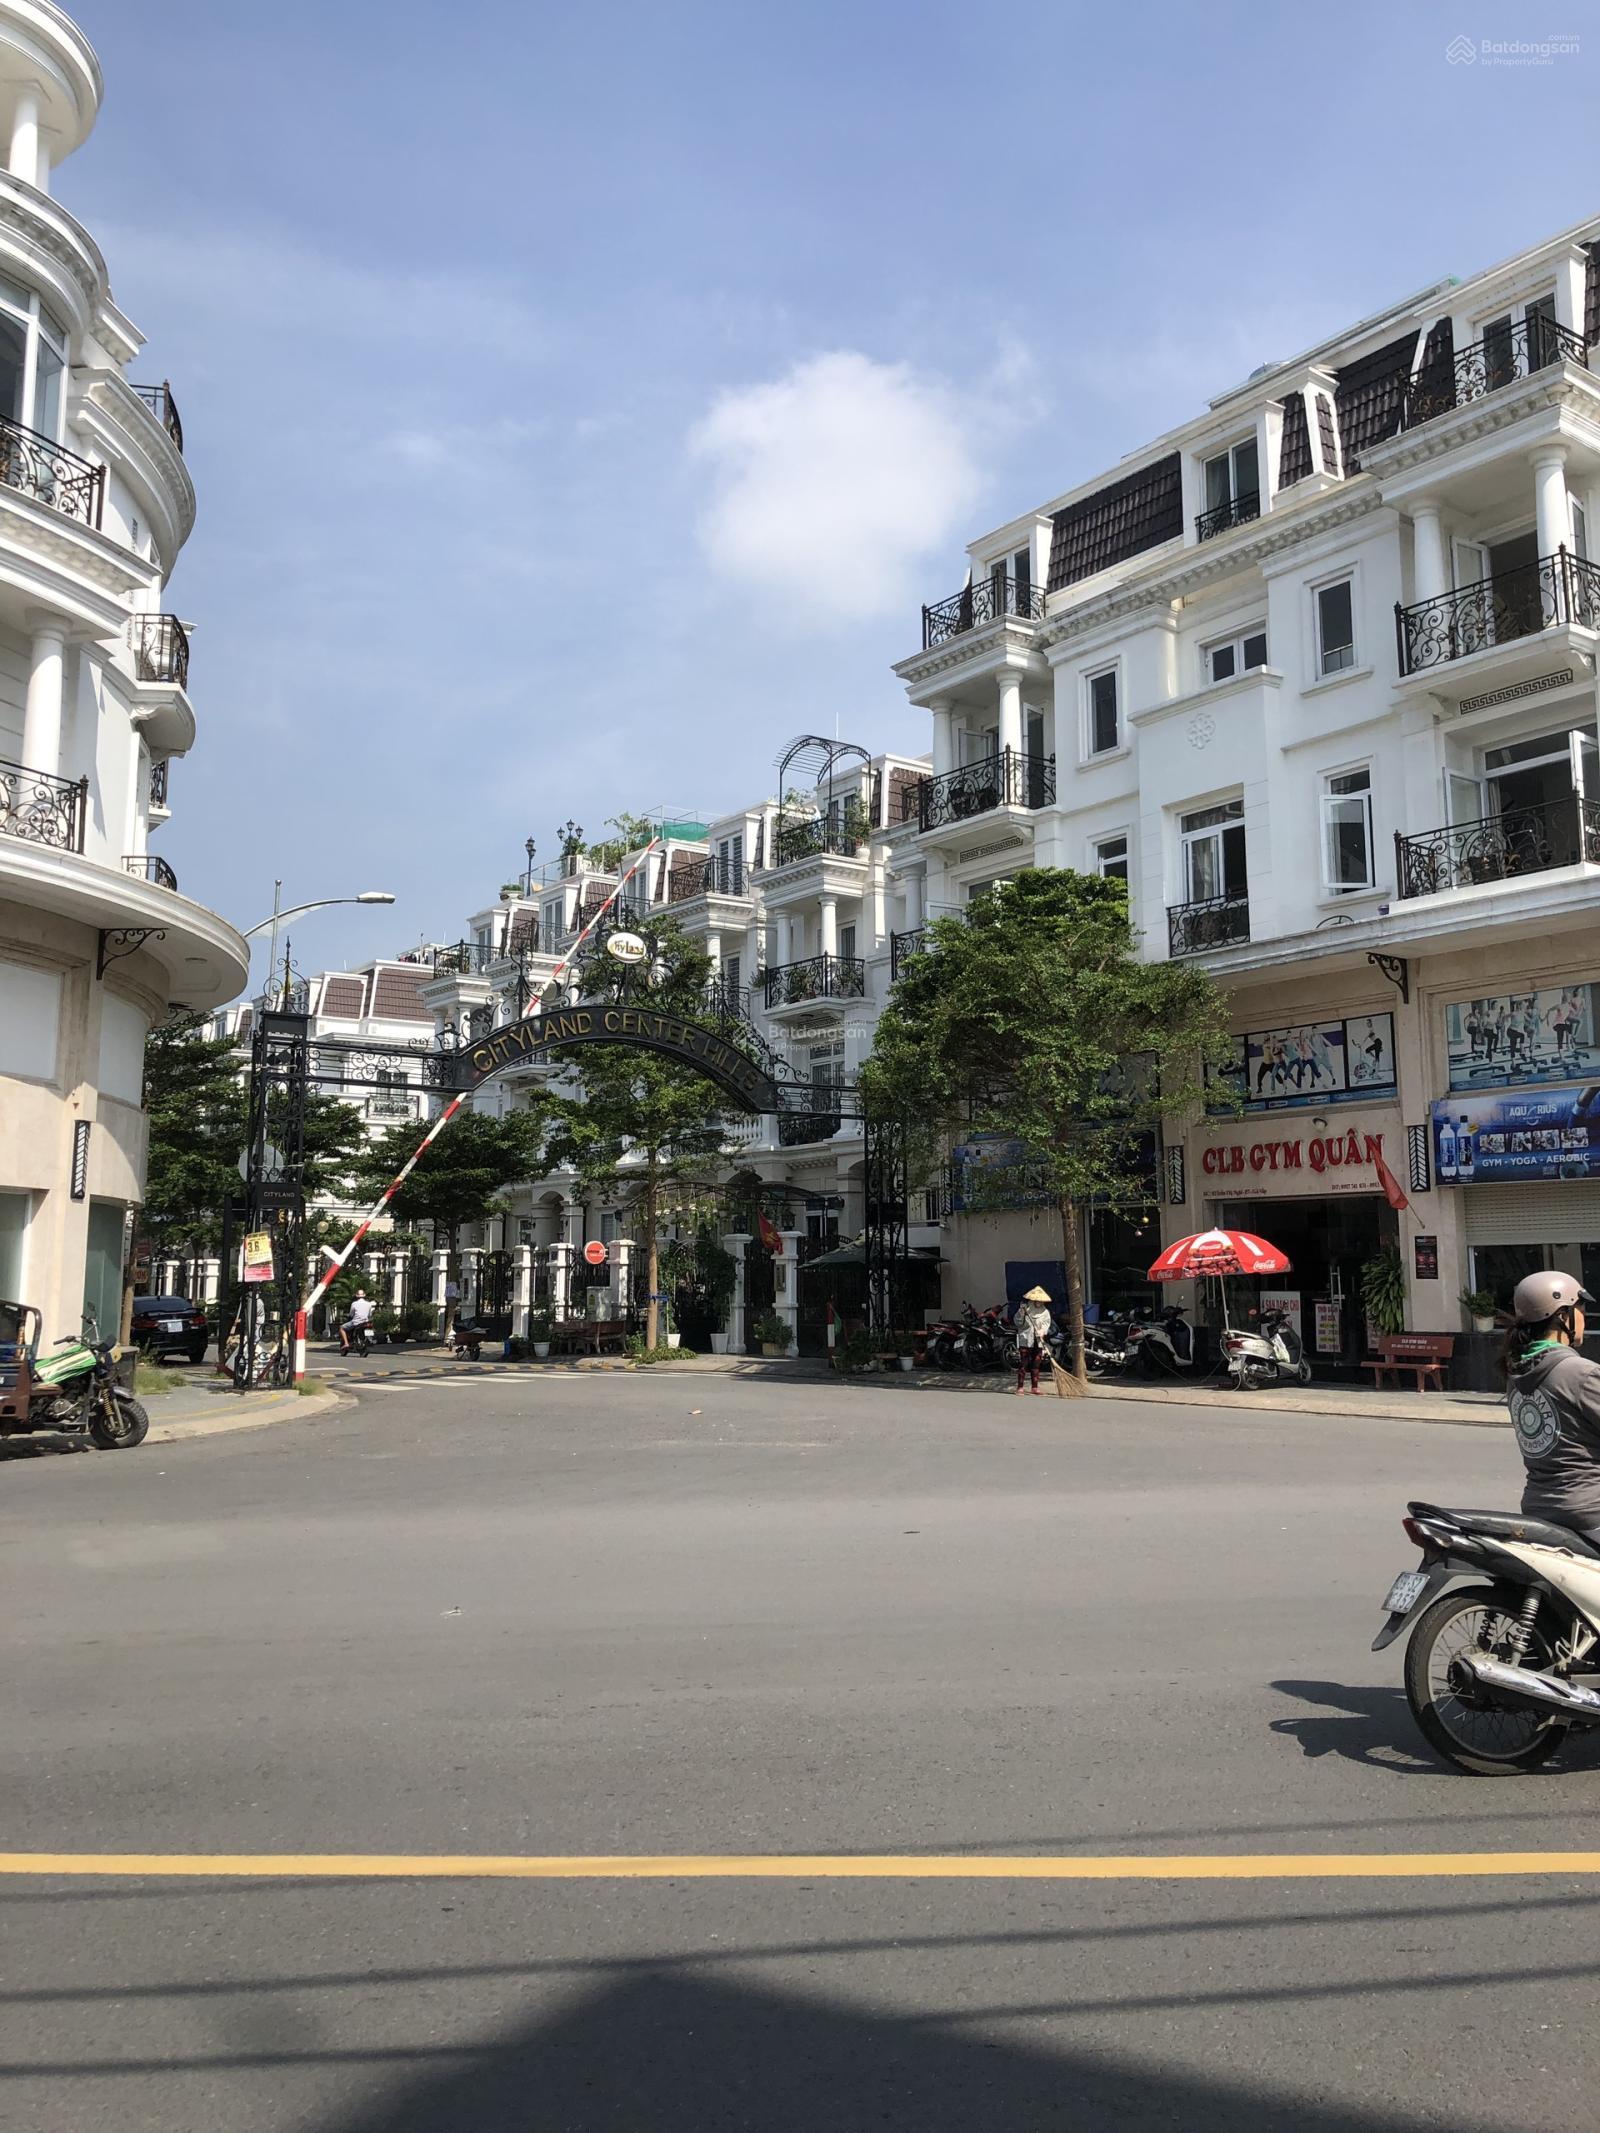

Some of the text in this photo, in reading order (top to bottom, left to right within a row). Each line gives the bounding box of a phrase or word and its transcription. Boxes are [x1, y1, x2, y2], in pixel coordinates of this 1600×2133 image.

[473, 1012, 592, 1072] CITYLAND
[604, 1011, 696, 1050] CENTER
[1202, 1127, 1385, 1174] CLB GYM QUÂN
[1482, 1158, 1502, 1168] GYM
[1510, 1156, 1537, 1166] YOGA
[1546, 1153, 1590, 1164] AEROBIC
